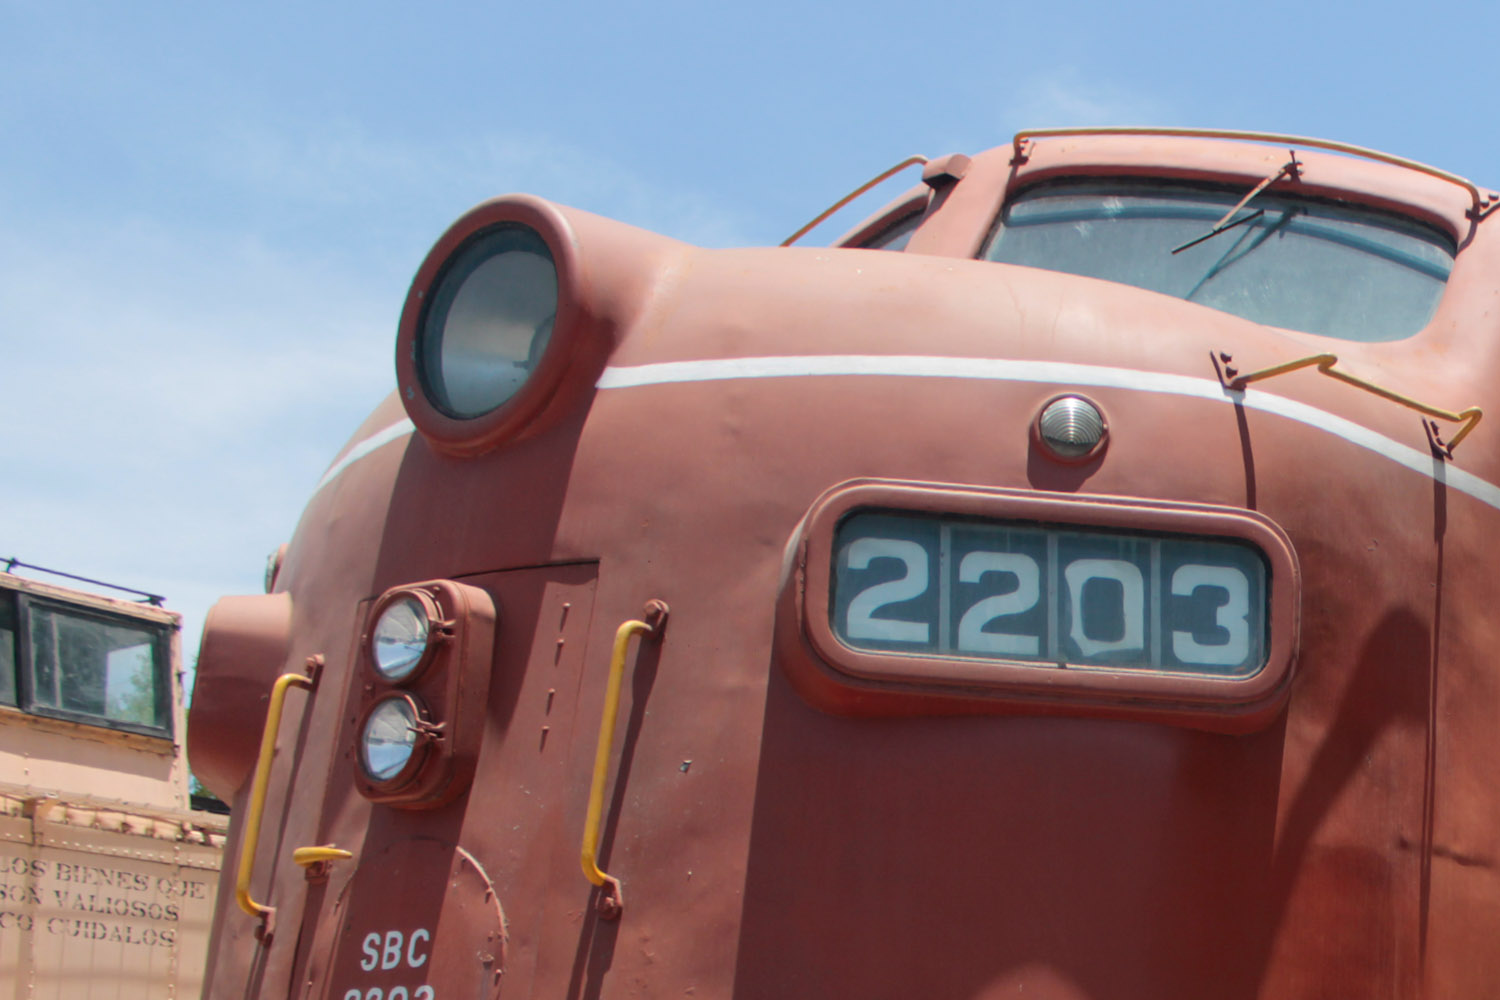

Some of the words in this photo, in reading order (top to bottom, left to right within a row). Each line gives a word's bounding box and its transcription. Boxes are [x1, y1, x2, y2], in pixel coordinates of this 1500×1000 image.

[846, 537, 1250, 666] 2203
[0, 856, 47, 878] OS
[55, 862, 149, 892] BIENES
[54, 889, 179, 922] VALIOSOS
[47, 917, 175, 948] CUIDALOS
[360, 928, 430, 972] SBC
